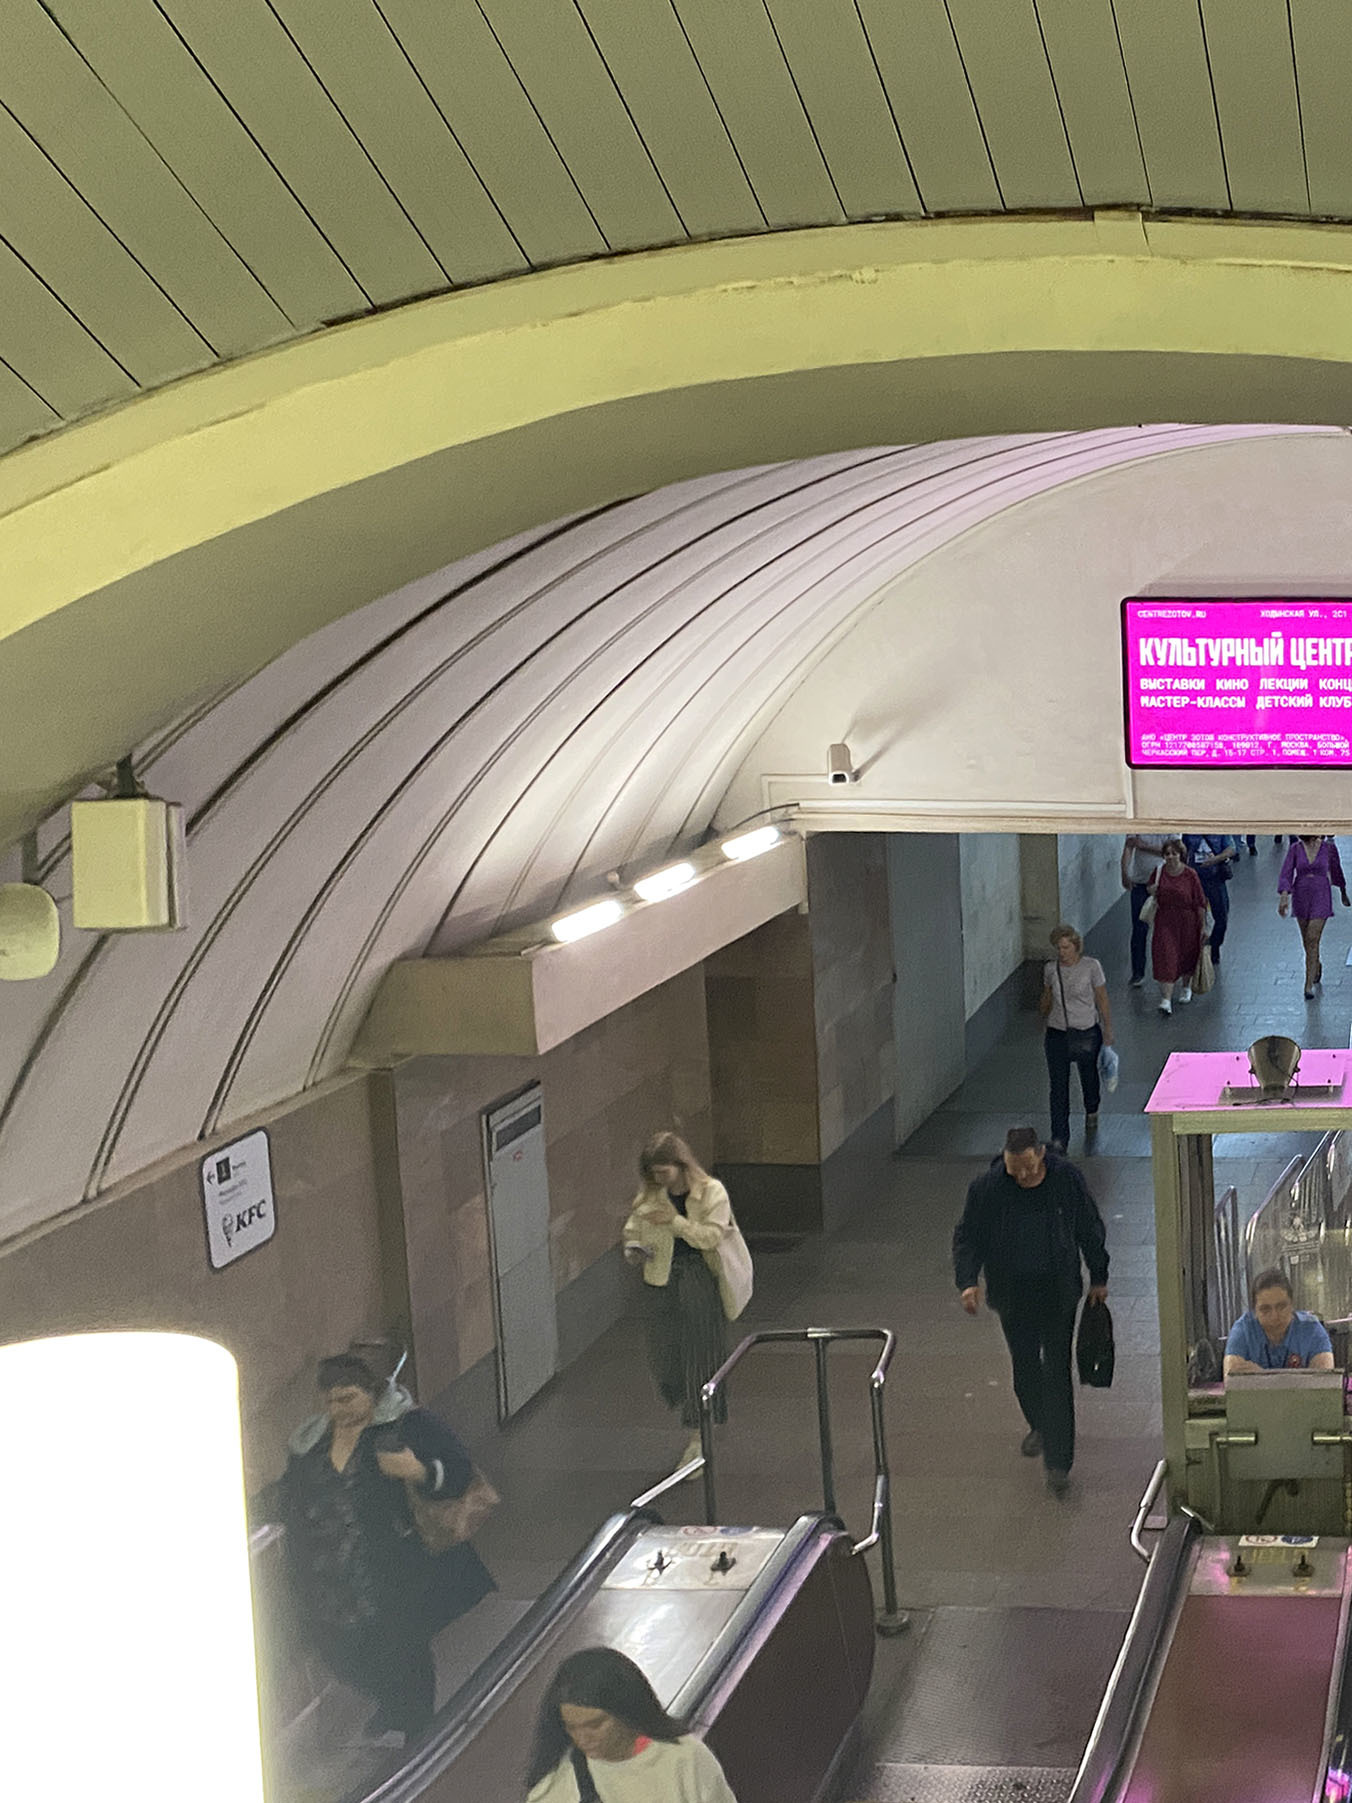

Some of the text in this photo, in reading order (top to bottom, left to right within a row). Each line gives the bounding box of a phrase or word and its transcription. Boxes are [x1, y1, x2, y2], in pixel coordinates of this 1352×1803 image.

[1139, 631, 1285, 667] КУЛЬТУРНЫЙ
[1140, 678, 1206, 691] ВЫСТАВКИ
[1216, 678, 1249, 691] КИНО
[1259, 678, 1309, 692] ЛЕКЦИИ
[1139, 693, 1352, 710] МАСТЕР-КЛАССЫ ДЕТСКИЙ КЛУБ
[235, 1199, 267, 1233] KFC
